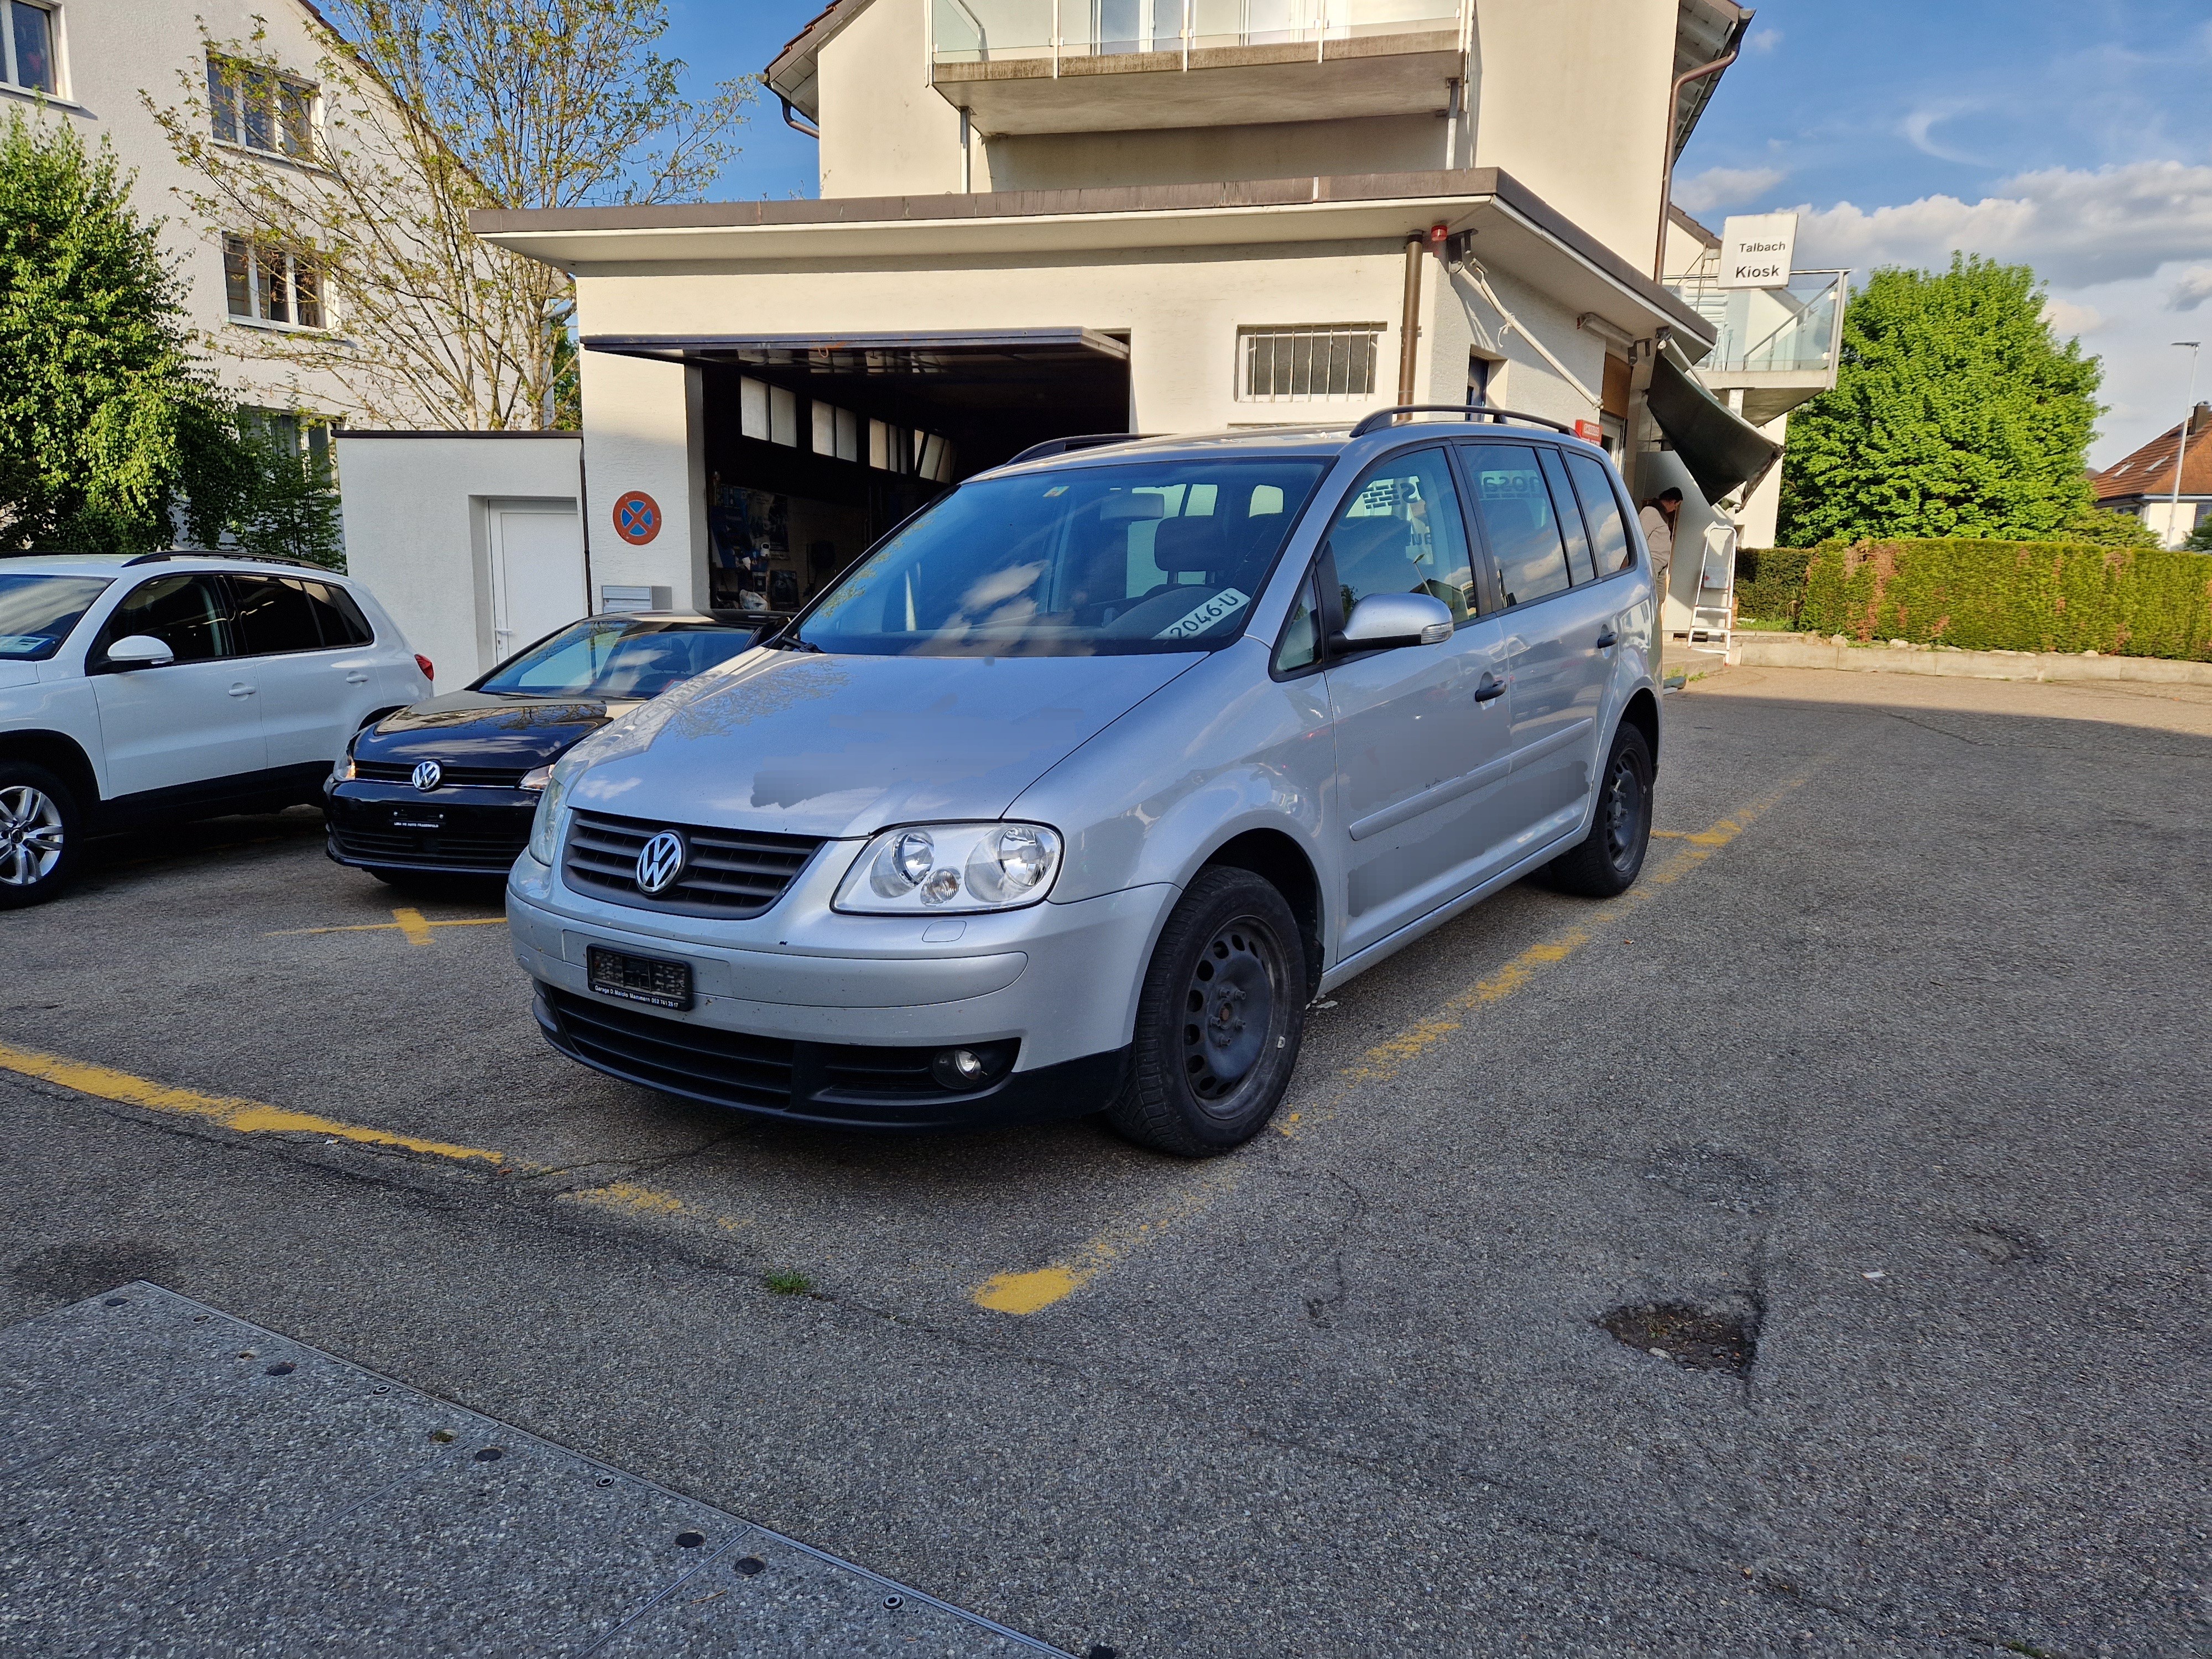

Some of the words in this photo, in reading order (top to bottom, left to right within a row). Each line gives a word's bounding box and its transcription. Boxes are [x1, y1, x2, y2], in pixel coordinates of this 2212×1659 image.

[1739, 241, 1786, 253] Talbach
[1735, 264, 1780, 278] Kiosk
[636, 833, 682, 891] VW
[595, 985, 609, 994] Garage
